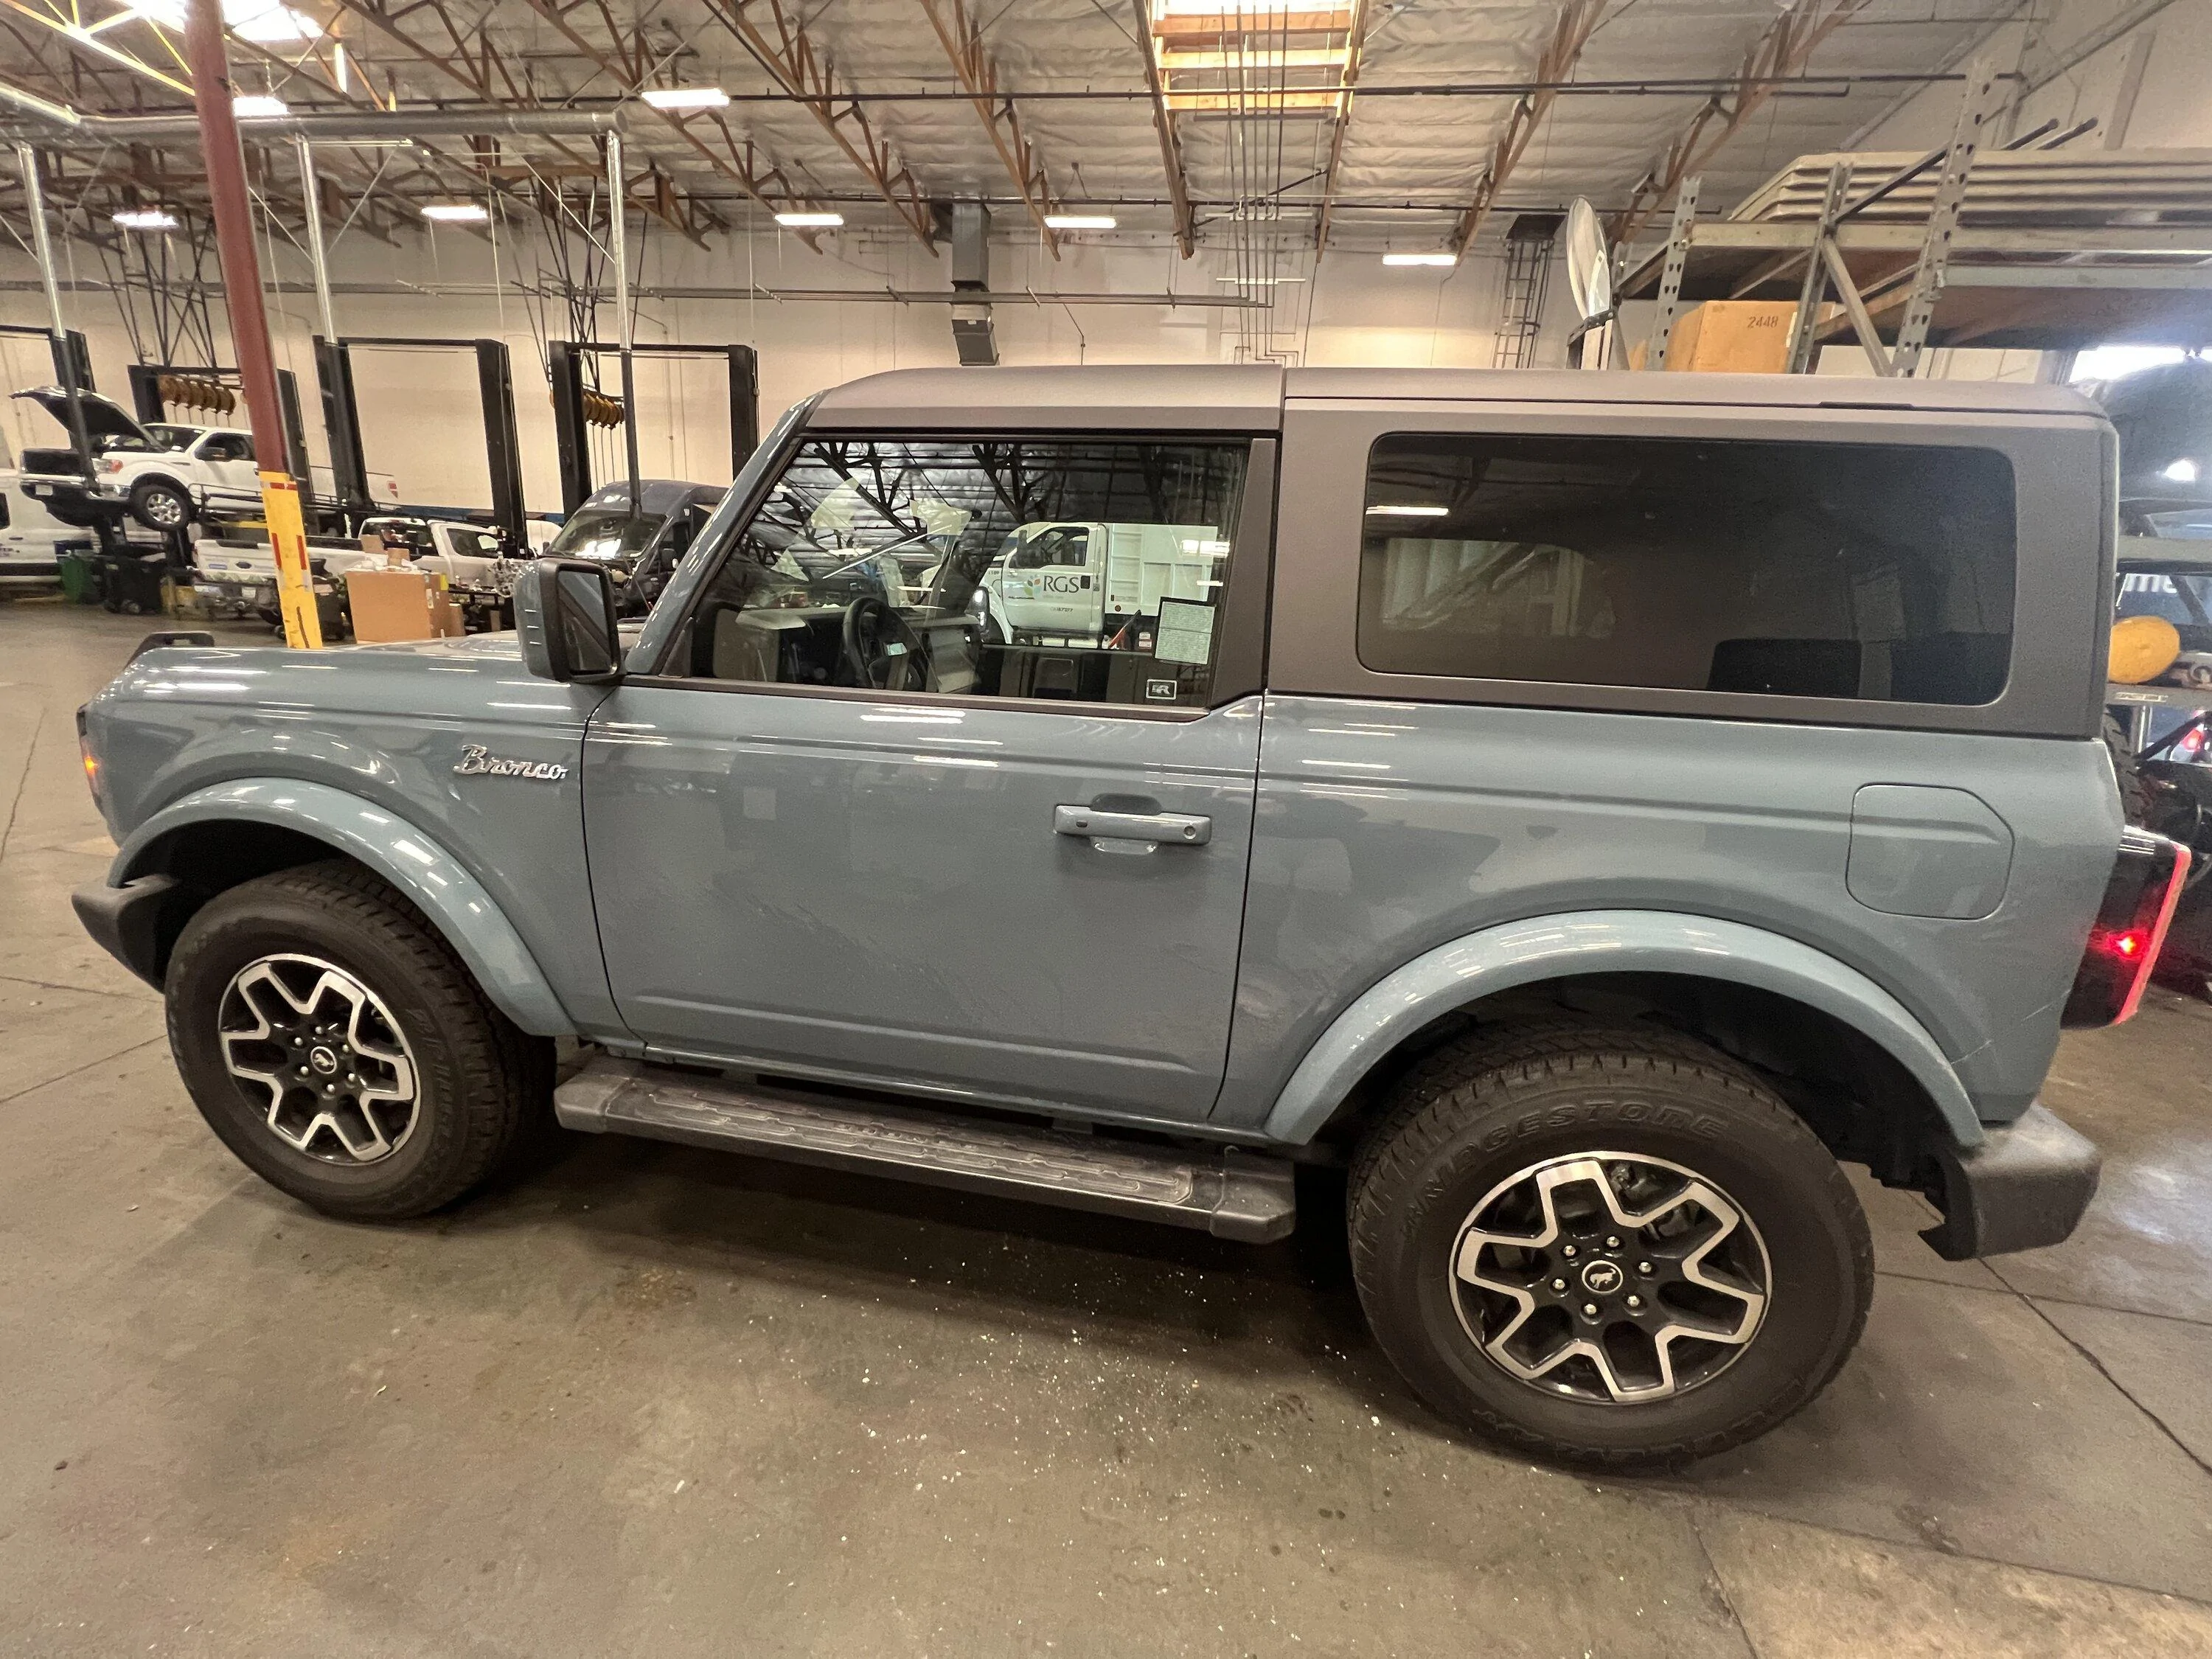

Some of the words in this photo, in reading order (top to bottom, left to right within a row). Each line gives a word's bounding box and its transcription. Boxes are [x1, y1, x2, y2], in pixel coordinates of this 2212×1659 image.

[1747, 316, 1779, 328] 2448
[1043, 575, 1079, 594] RGS
[453, 743, 570, 780] Bronco
